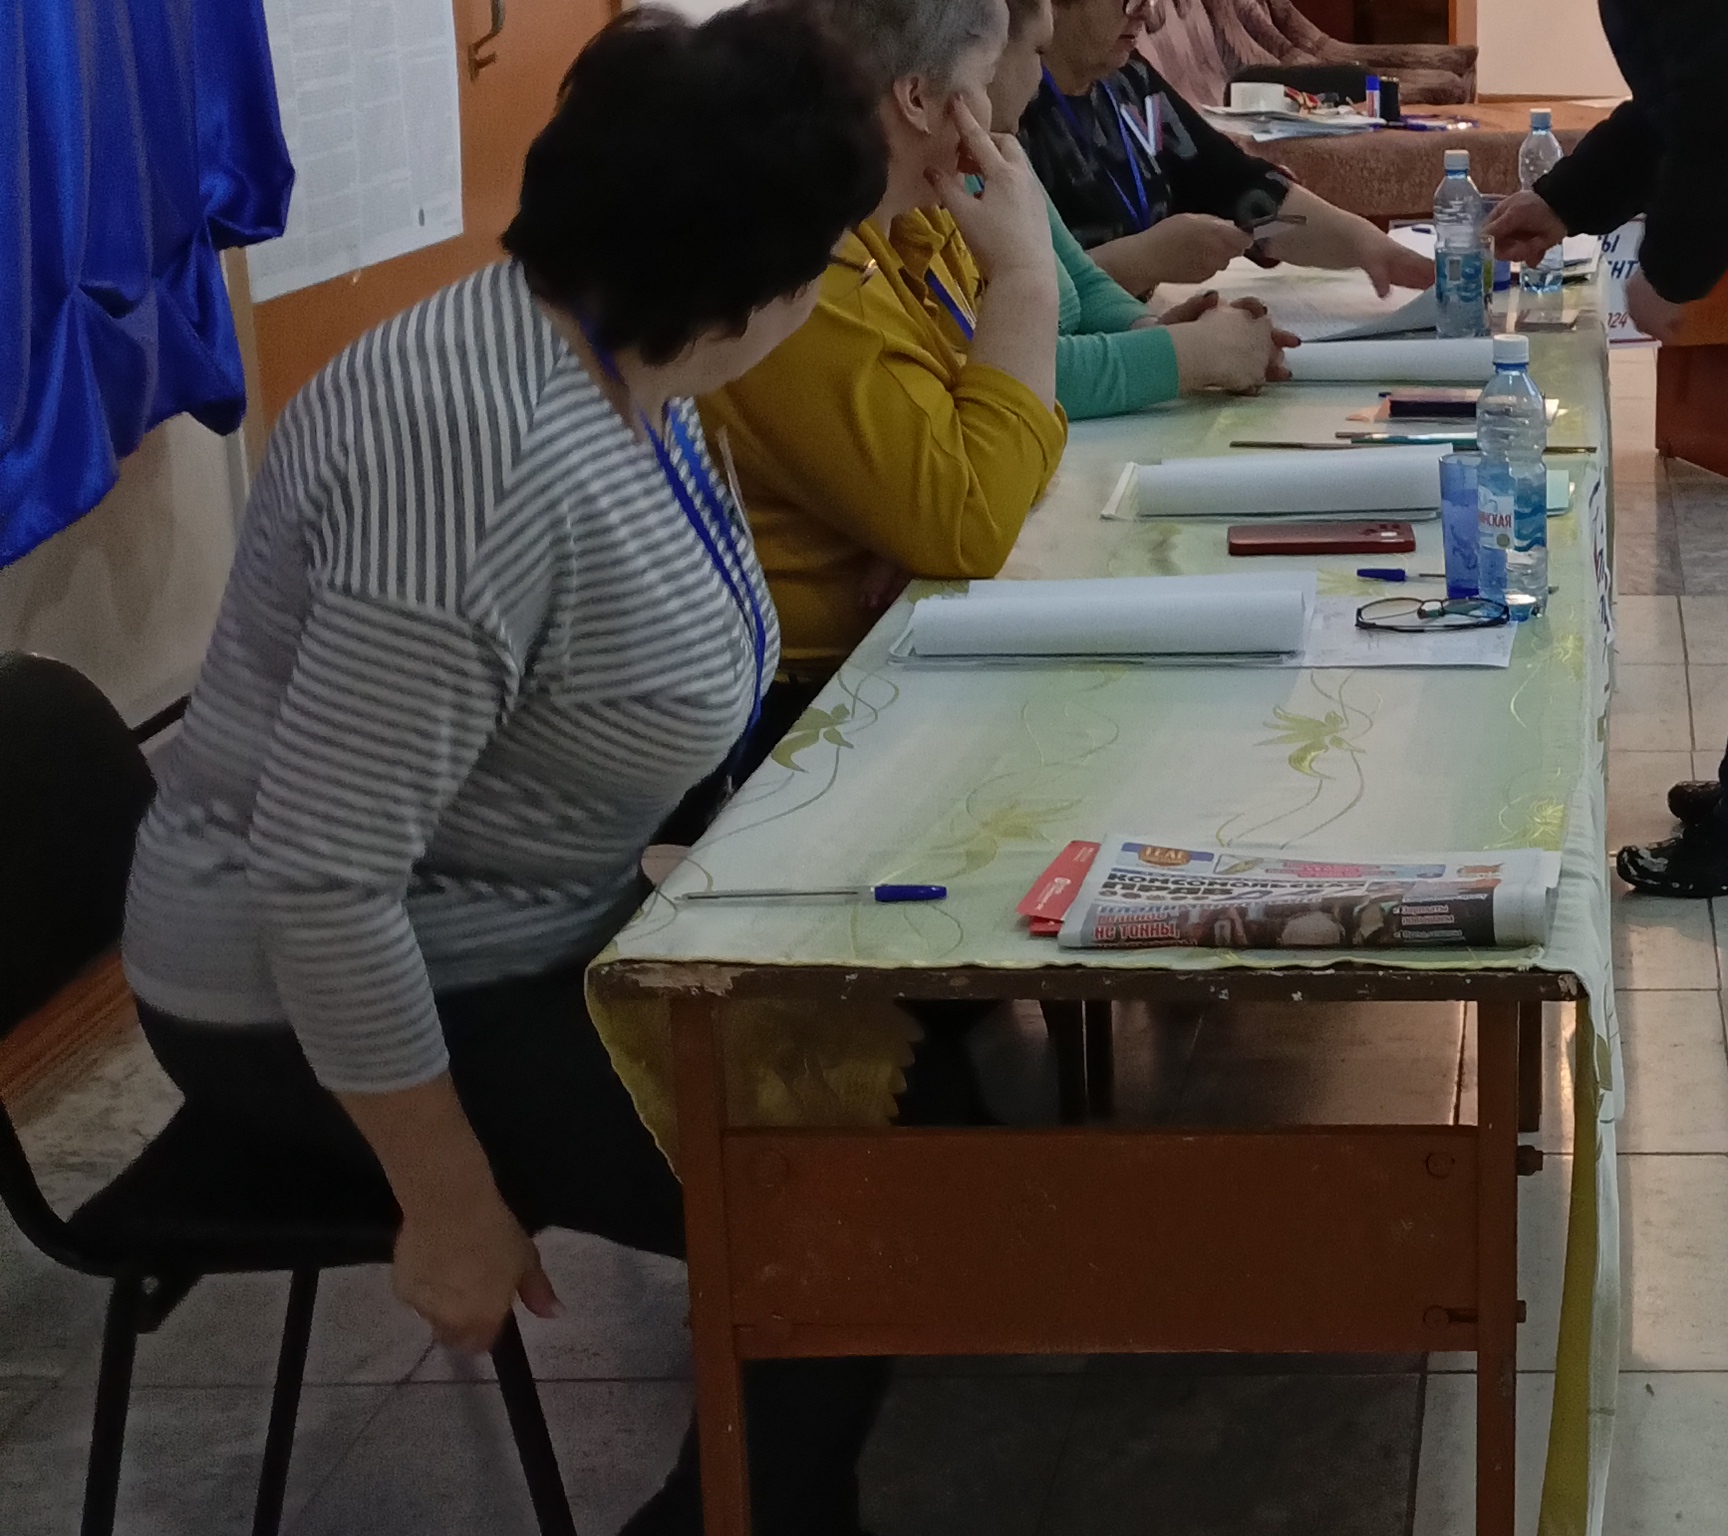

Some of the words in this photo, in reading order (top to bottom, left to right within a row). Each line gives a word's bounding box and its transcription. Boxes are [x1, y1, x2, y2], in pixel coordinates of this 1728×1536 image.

[1598, 234, 1621, 253] Ы
[1608, 260, 1640, 279] НТ
[1106, 872, 1365, 889] КОМСОМОЛЬСКАЯ
